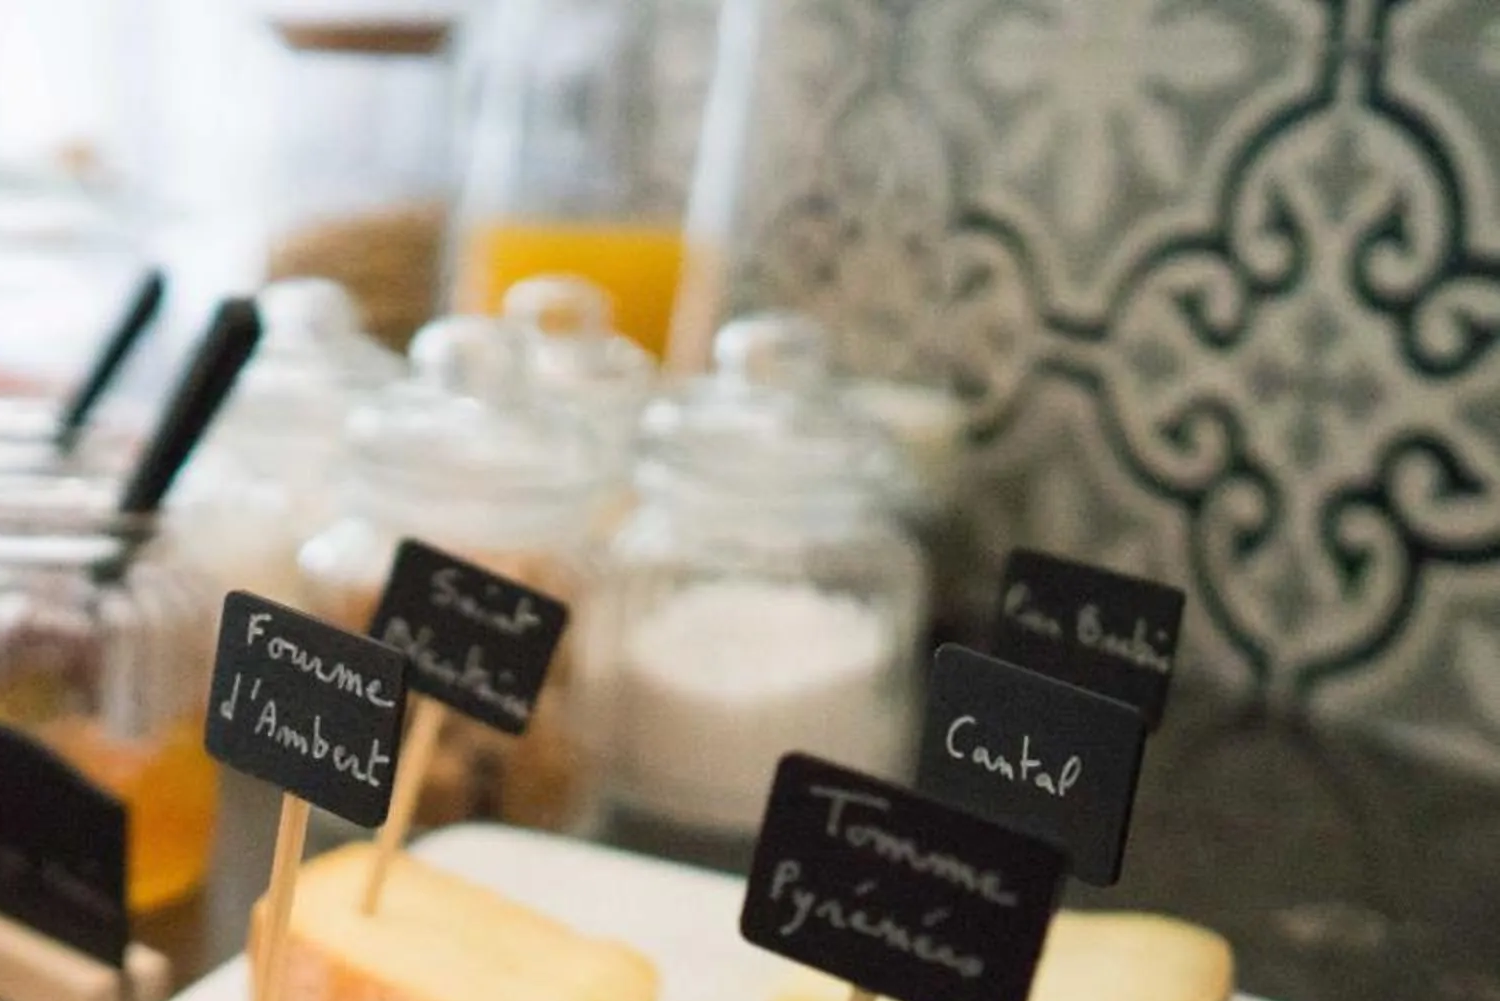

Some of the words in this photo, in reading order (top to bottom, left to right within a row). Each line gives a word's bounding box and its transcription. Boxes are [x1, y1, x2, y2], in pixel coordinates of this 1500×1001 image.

[246, 613, 396, 708] Fourme
[219, 672, 390, 787] d'Ambert
[945, 715, 1083, 796] Cantal
[809, 785, 1019, 907] Tomme
